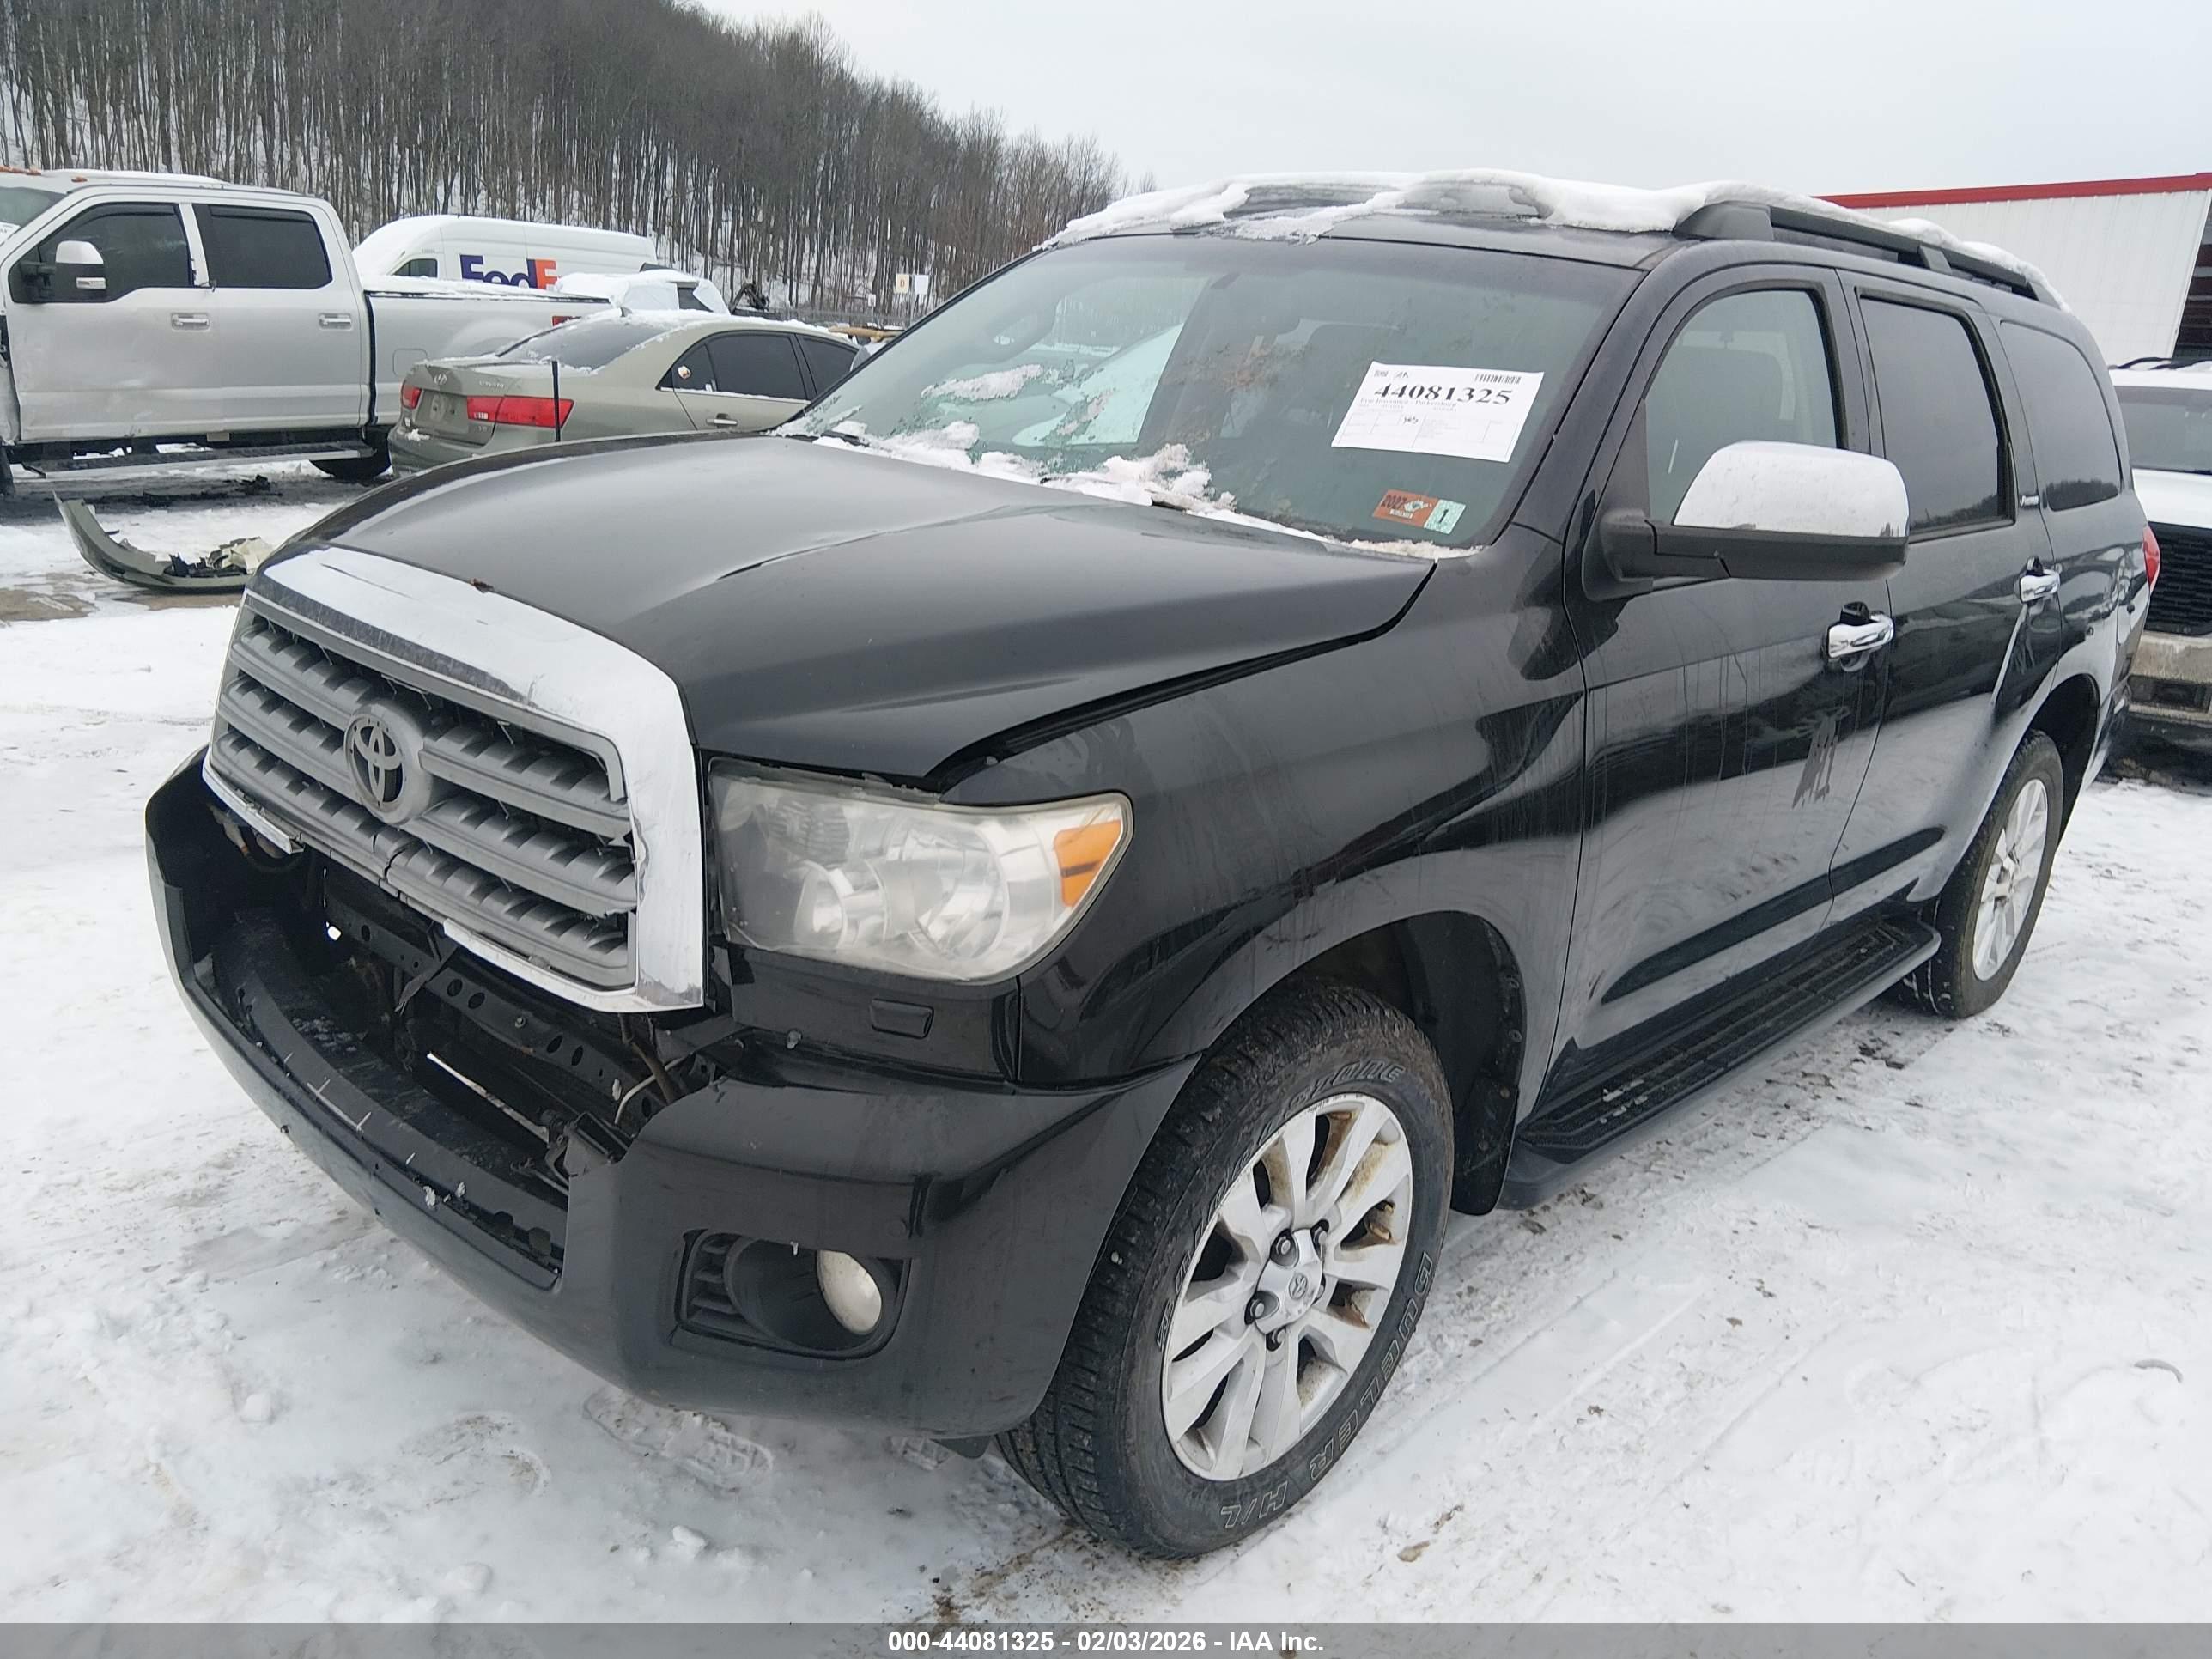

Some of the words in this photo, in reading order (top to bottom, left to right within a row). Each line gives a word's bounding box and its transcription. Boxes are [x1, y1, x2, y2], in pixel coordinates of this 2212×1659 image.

[459, 254, 558, 289] FedE
[1374, 383, 1513, 406] 44081325
[1310, 1251, 1434, 1481] DUELER
